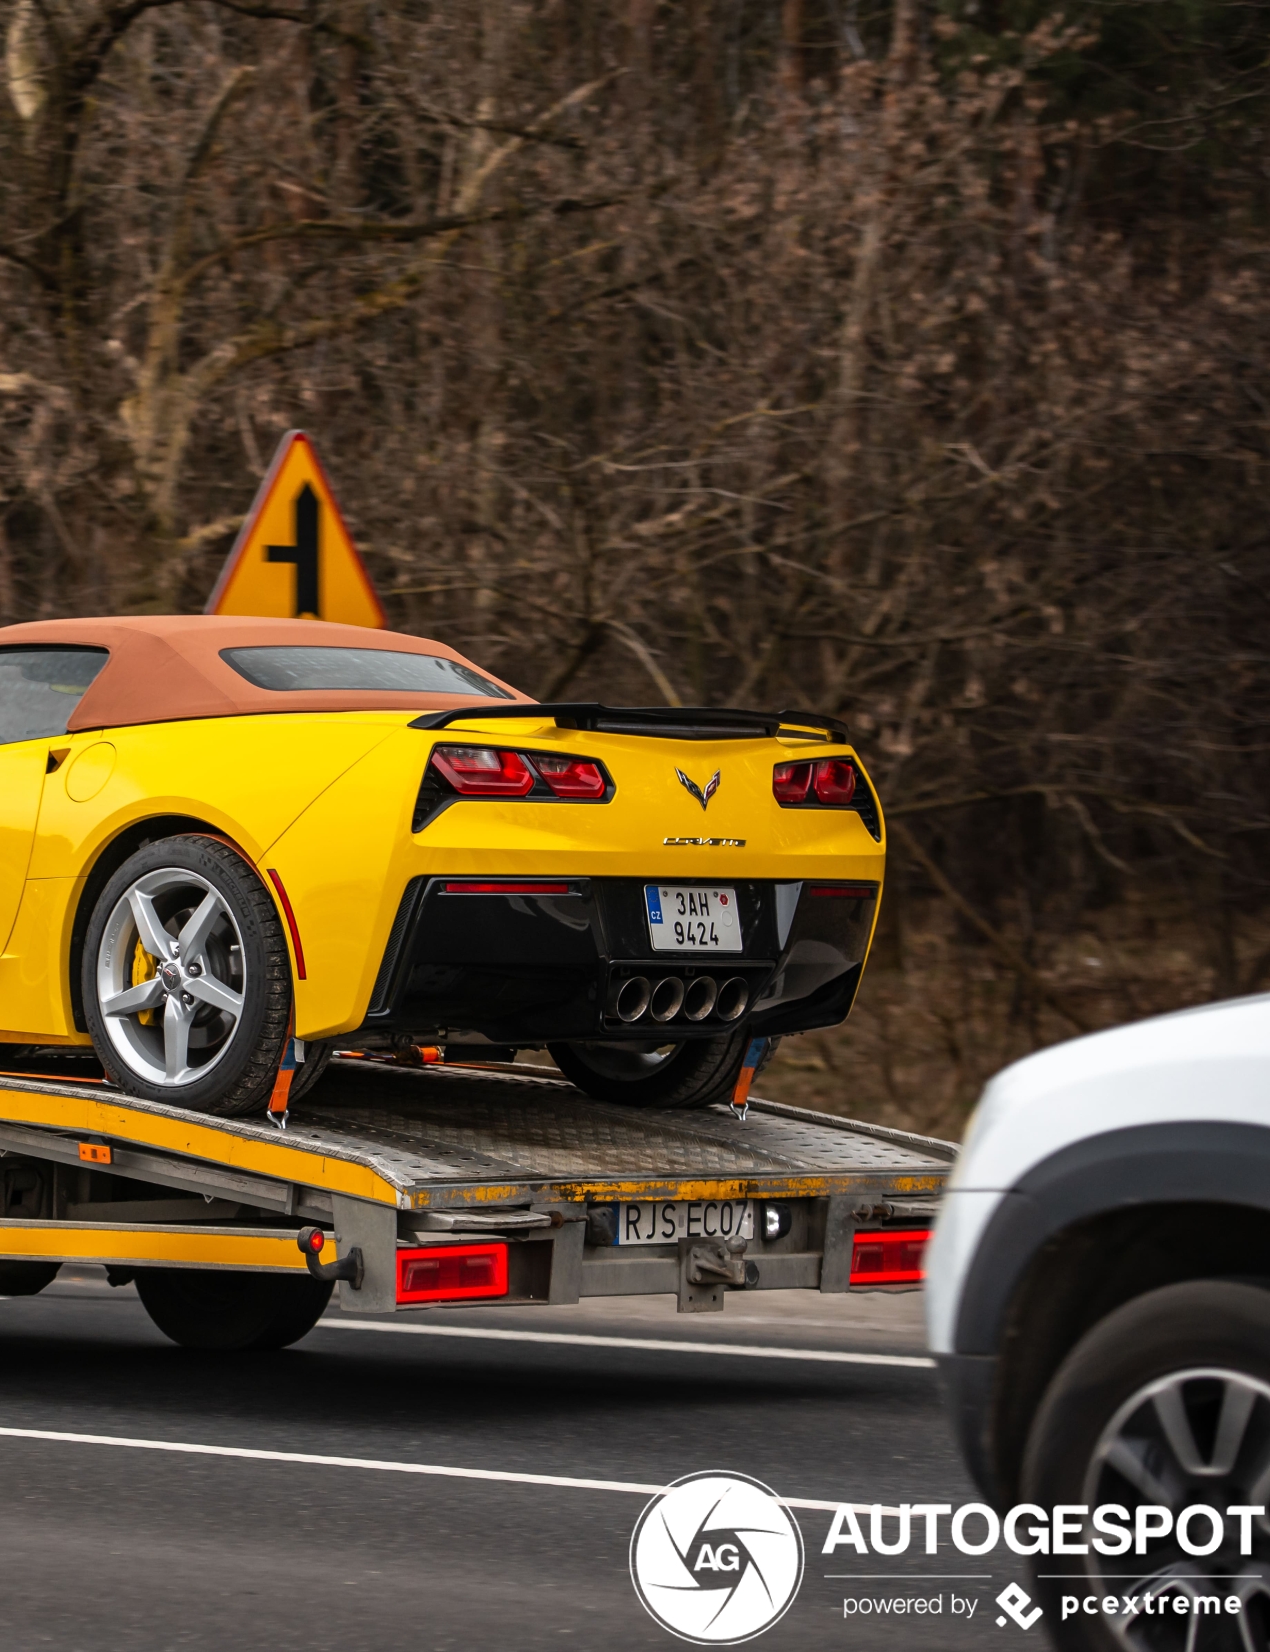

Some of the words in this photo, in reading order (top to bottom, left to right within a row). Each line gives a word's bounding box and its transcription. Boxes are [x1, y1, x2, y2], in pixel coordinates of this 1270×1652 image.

[651, 911, 661, 920] CZ
[676, 892, 710, 916] 3AH
[674, 921, 719, 946] 9424
[626, 1203, 676, 1241] RJS
[687, 1200, 748, 1237] EC07
